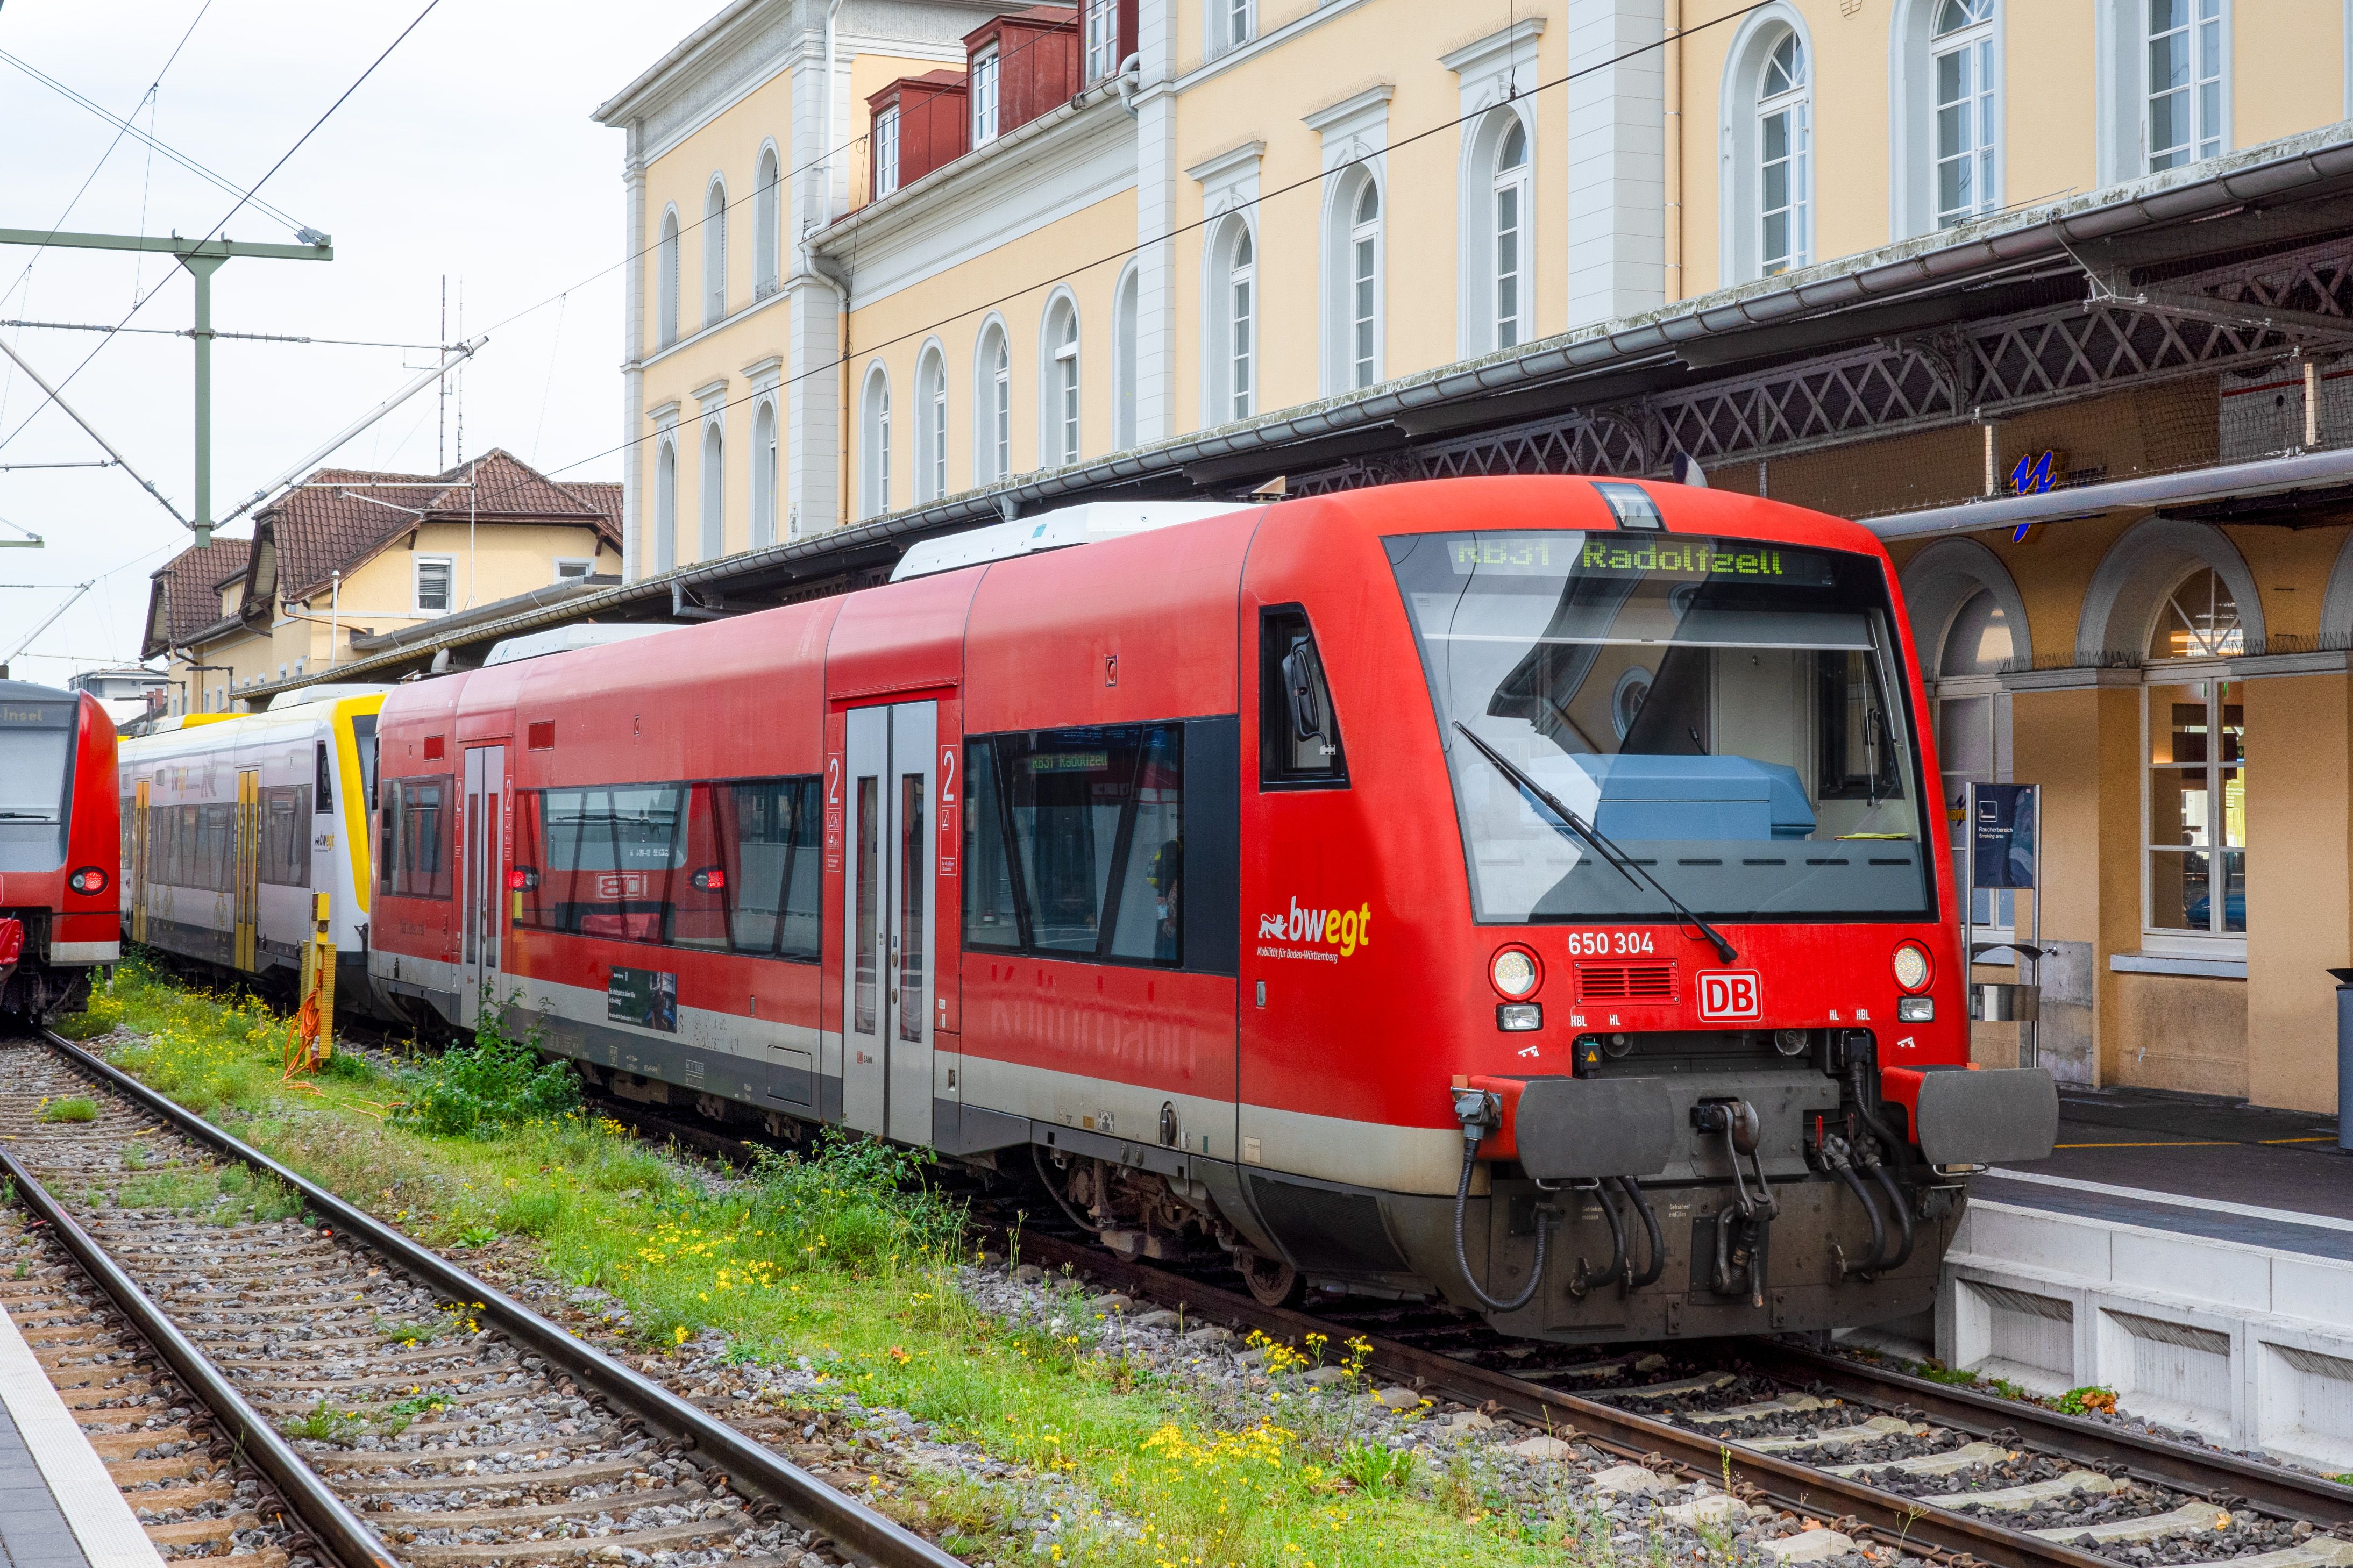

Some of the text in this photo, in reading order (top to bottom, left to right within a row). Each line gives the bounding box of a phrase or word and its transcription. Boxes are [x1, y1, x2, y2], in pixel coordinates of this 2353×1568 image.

[1583, 541, 1782, 574] Radolfzell
[829, 758, 839, 804] 2
[943, 750, 954, 801] 2
[457, 781, 461, 812] 2
[506, 779, 511, 811] 2
[1289, 895, 1371, 957] bwegt
[1257, 946, 1338, 964] Mobilität für Baden-Württemberg
[1569, 932, 1654, 955] 650 304
[1706, 979, 1754, 1013] DB
[1571, 1014, 1620, 1027] HBL HL
[1830, 1009, 1870, 1021] HL HBL
[863, 1055, 872, 1064] BAHN
